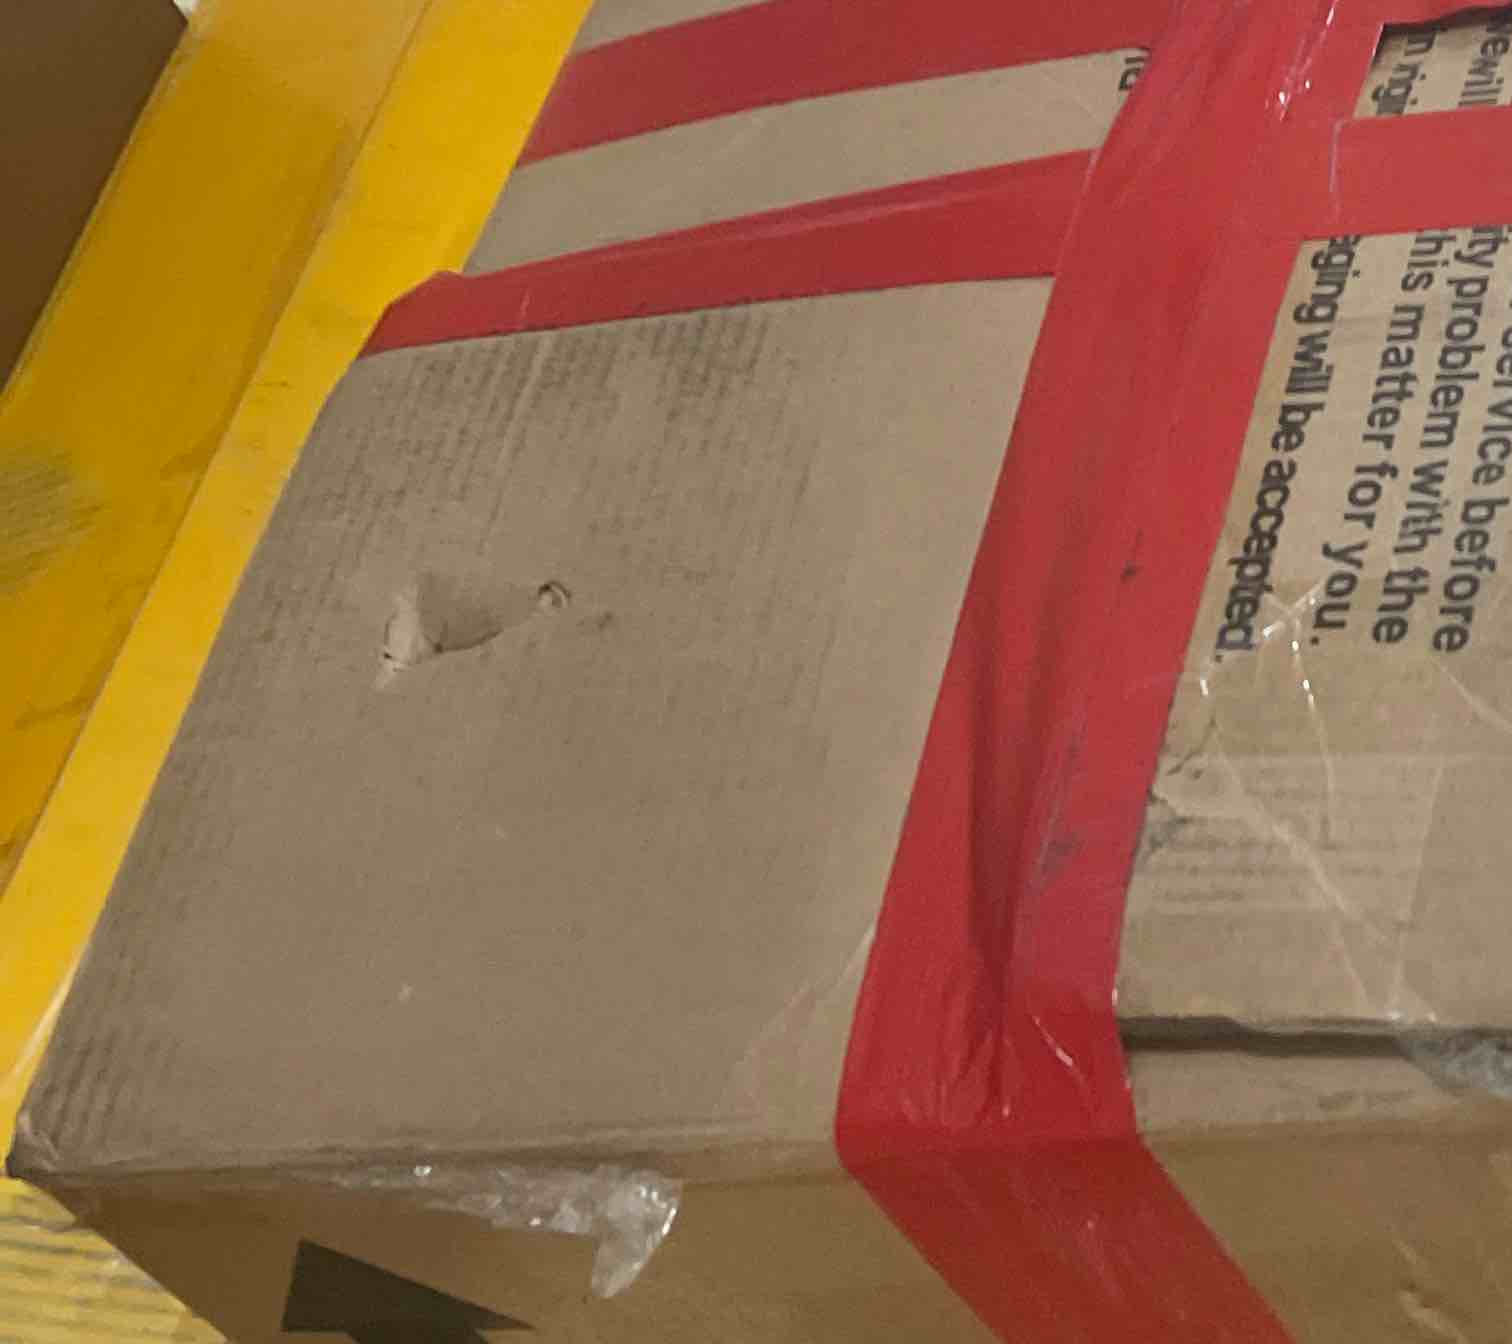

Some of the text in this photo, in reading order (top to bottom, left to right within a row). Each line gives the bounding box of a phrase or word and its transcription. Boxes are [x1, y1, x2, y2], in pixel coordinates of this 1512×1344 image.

[1284, 327, 1336, 397] will
[1361, 302, 1426, 451] matter
[1418, 274, 1490, 450] problem
[1270, 402, 1326, 454] be
[1342, 460, 1399, 529] for
[1393, 458, 1450, 555] with
[1213, 457, 1297, 664] accepted.
[1308, 540, 1369, 647] you.
[1371, 566, 1431, 646] the
[1430, 497, 1511, 654] before
